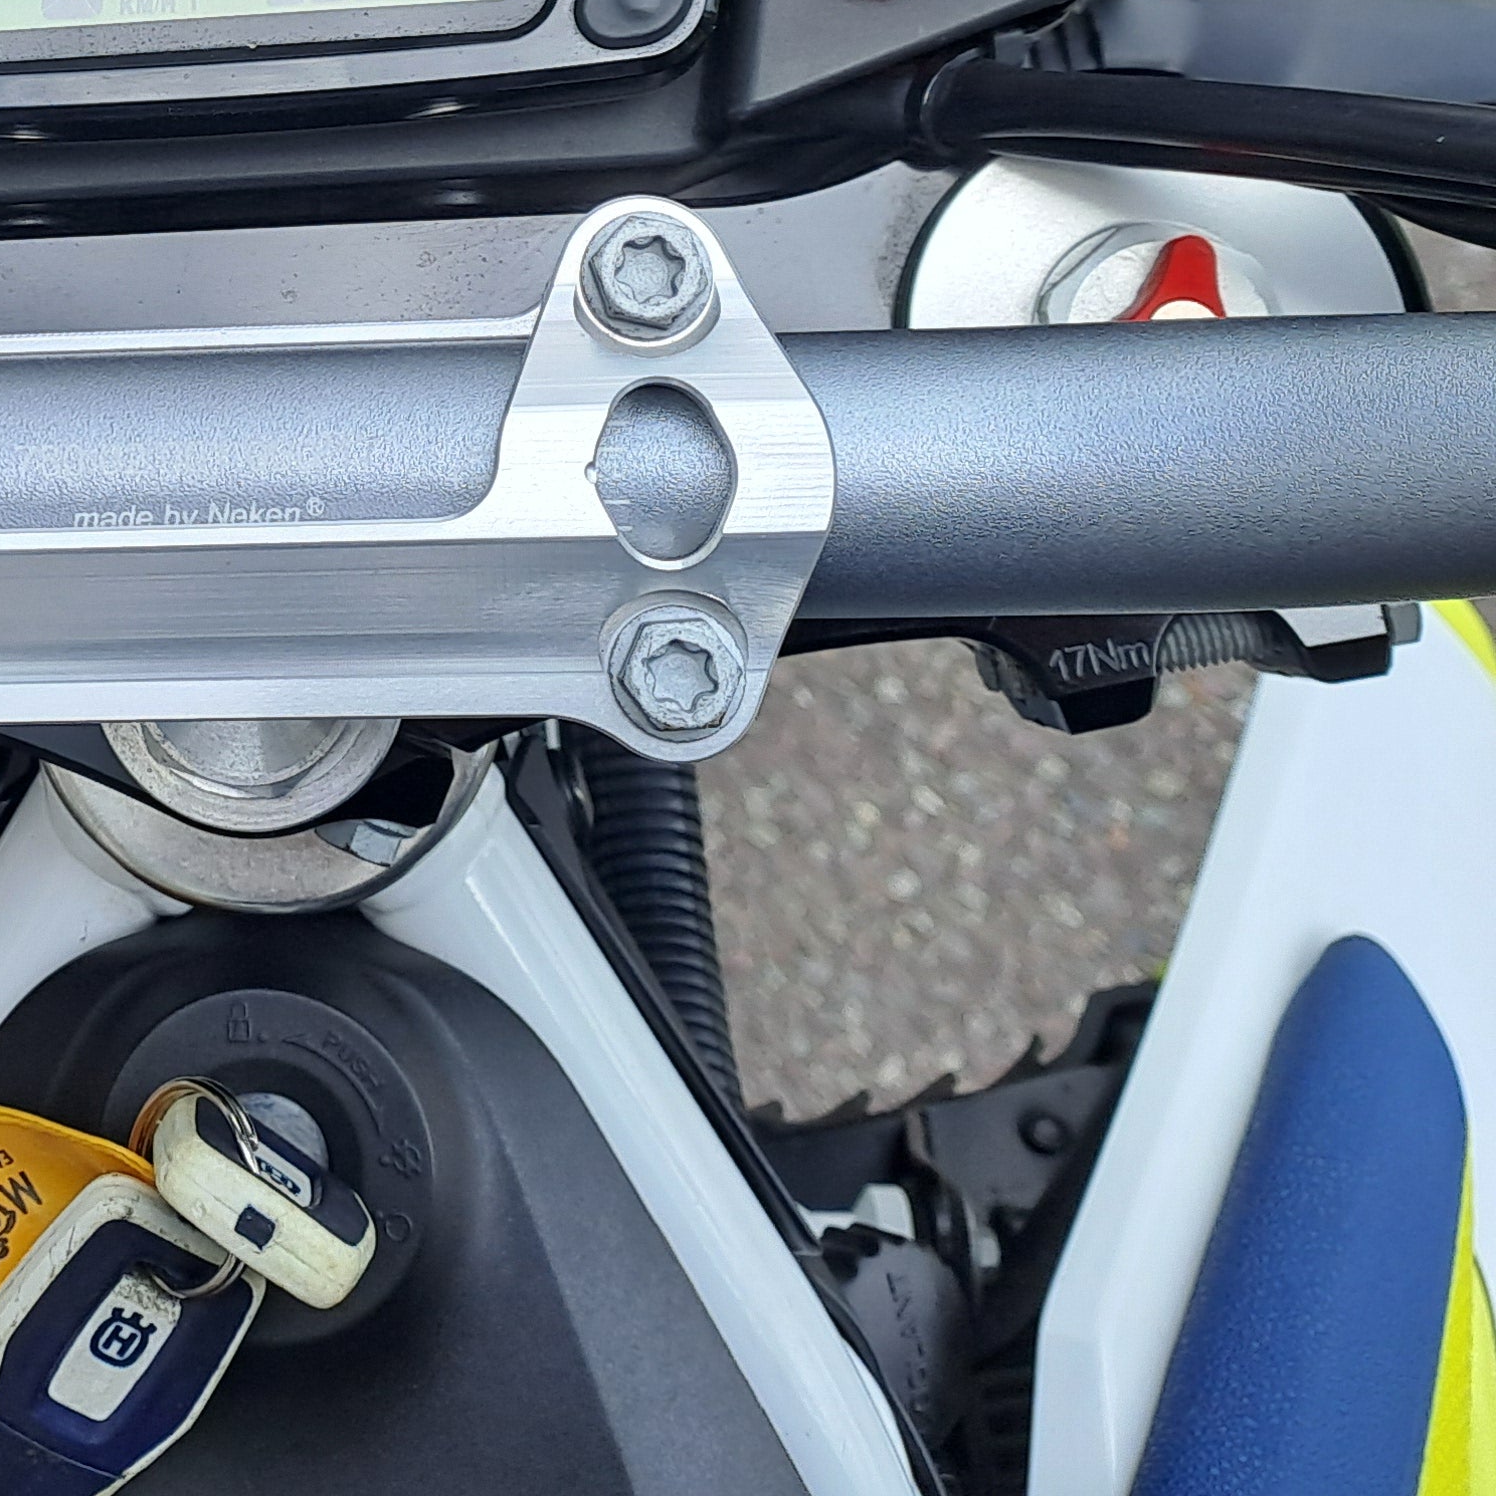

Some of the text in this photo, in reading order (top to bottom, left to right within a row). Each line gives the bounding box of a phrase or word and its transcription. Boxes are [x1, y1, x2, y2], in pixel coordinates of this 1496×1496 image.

[73, 505, 154, 528] made
[1049, 637, 1151, 681] 17Nm
[321, 1030, 381, 1092] PUSH
